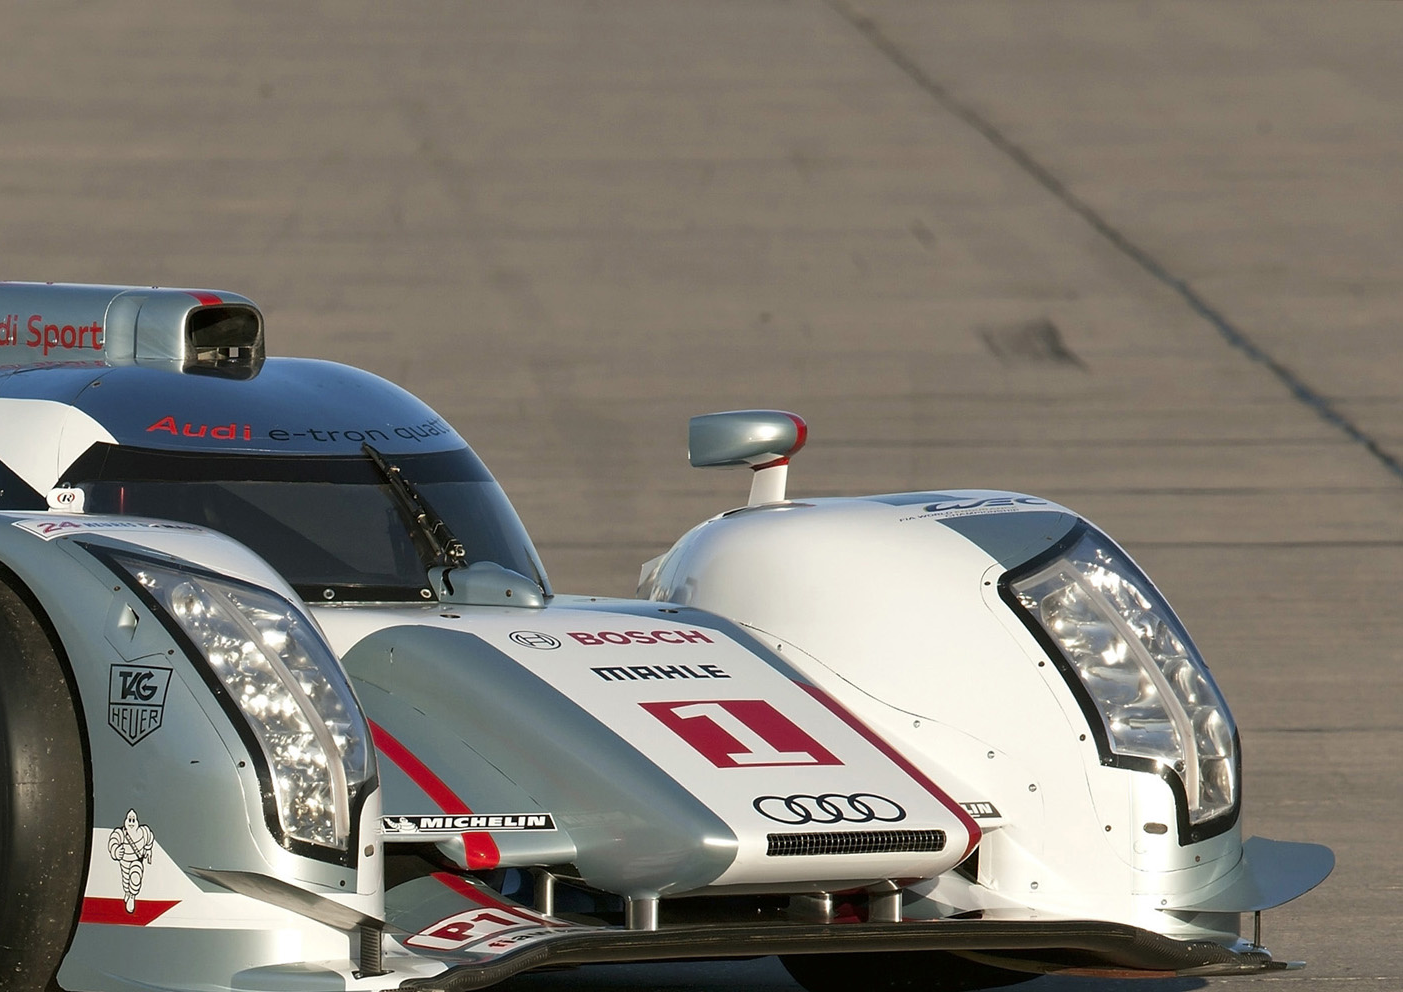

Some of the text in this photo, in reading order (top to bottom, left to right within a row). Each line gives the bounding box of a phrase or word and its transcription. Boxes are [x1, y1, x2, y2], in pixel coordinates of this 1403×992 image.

[25, 314, 104, 356] Sport
[145, 415, 252, 441] Audi
[268, 427, 390, 442] e-tron
[565, 629, 715, 646] BOSCH
[119, 670, 159, 702] TAG
[589, 664, 732, 682] MAHLE
[111, 706, 159, 740] HEUER
[668, 702, 820, 765] 1
[419, 815, 547, 829] MICHELIN
[427, 912, 521, 942] P1
